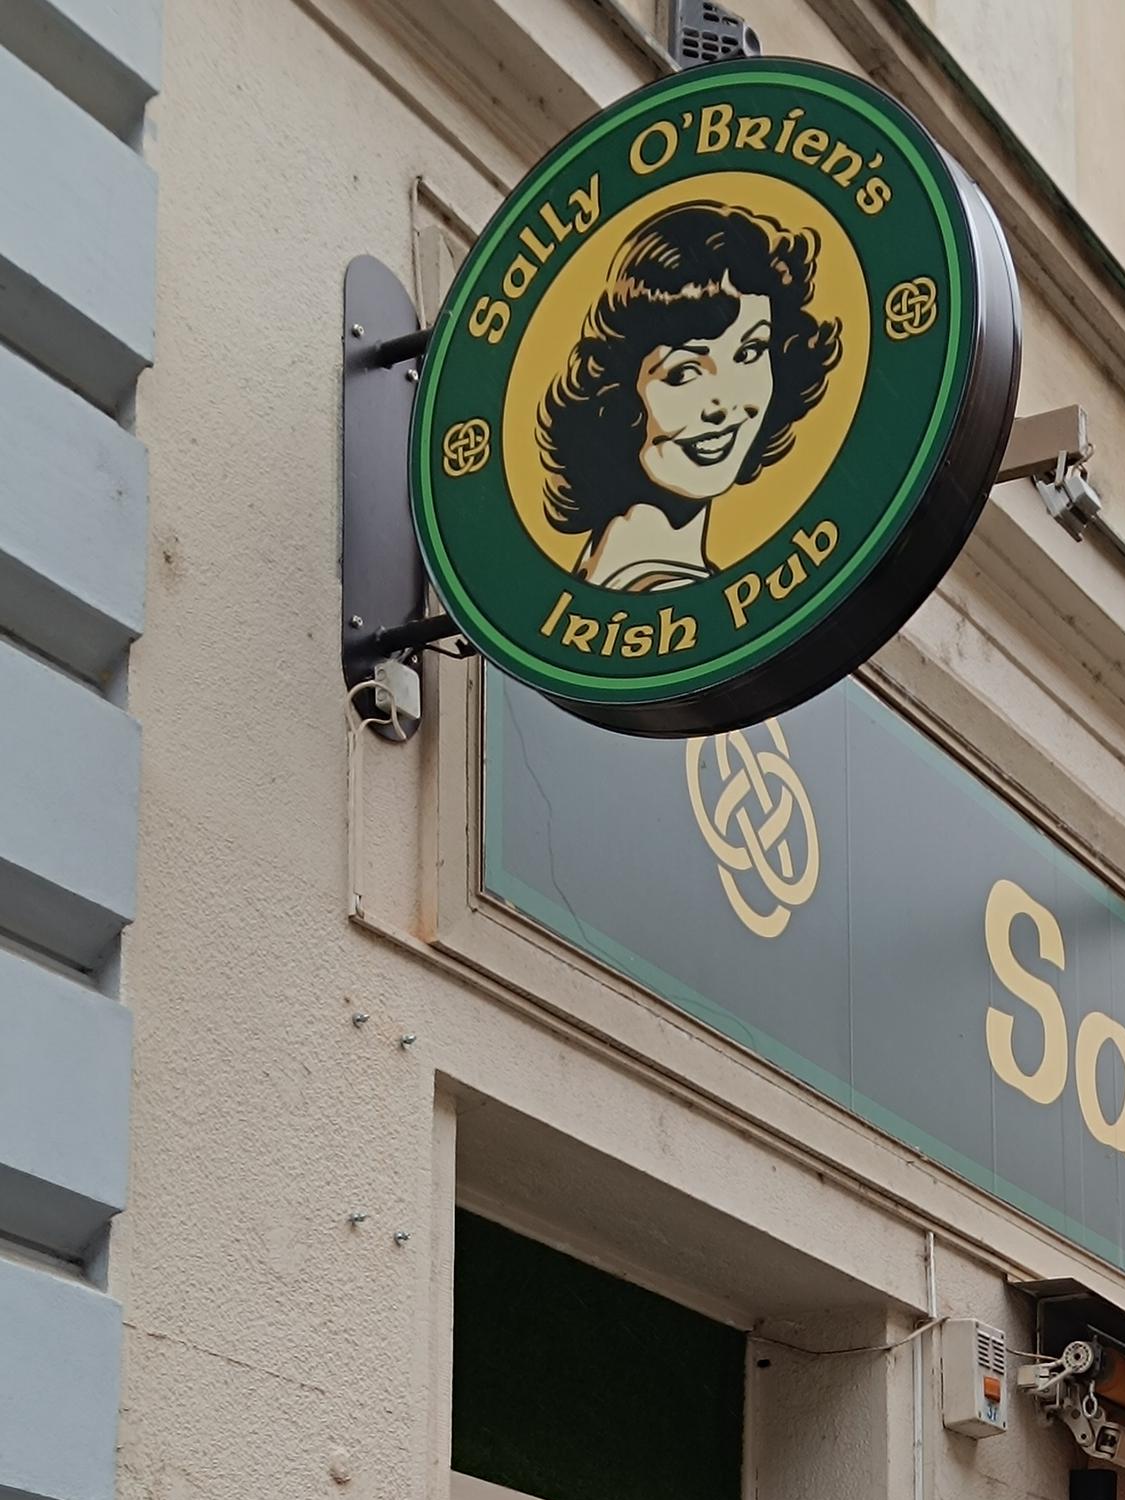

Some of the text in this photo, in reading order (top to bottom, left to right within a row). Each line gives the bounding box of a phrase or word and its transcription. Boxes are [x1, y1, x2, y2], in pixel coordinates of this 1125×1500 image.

[469, 103, 893, 346] Sally O'Brien's
[539, 518, 840, 659] Irish Pub
